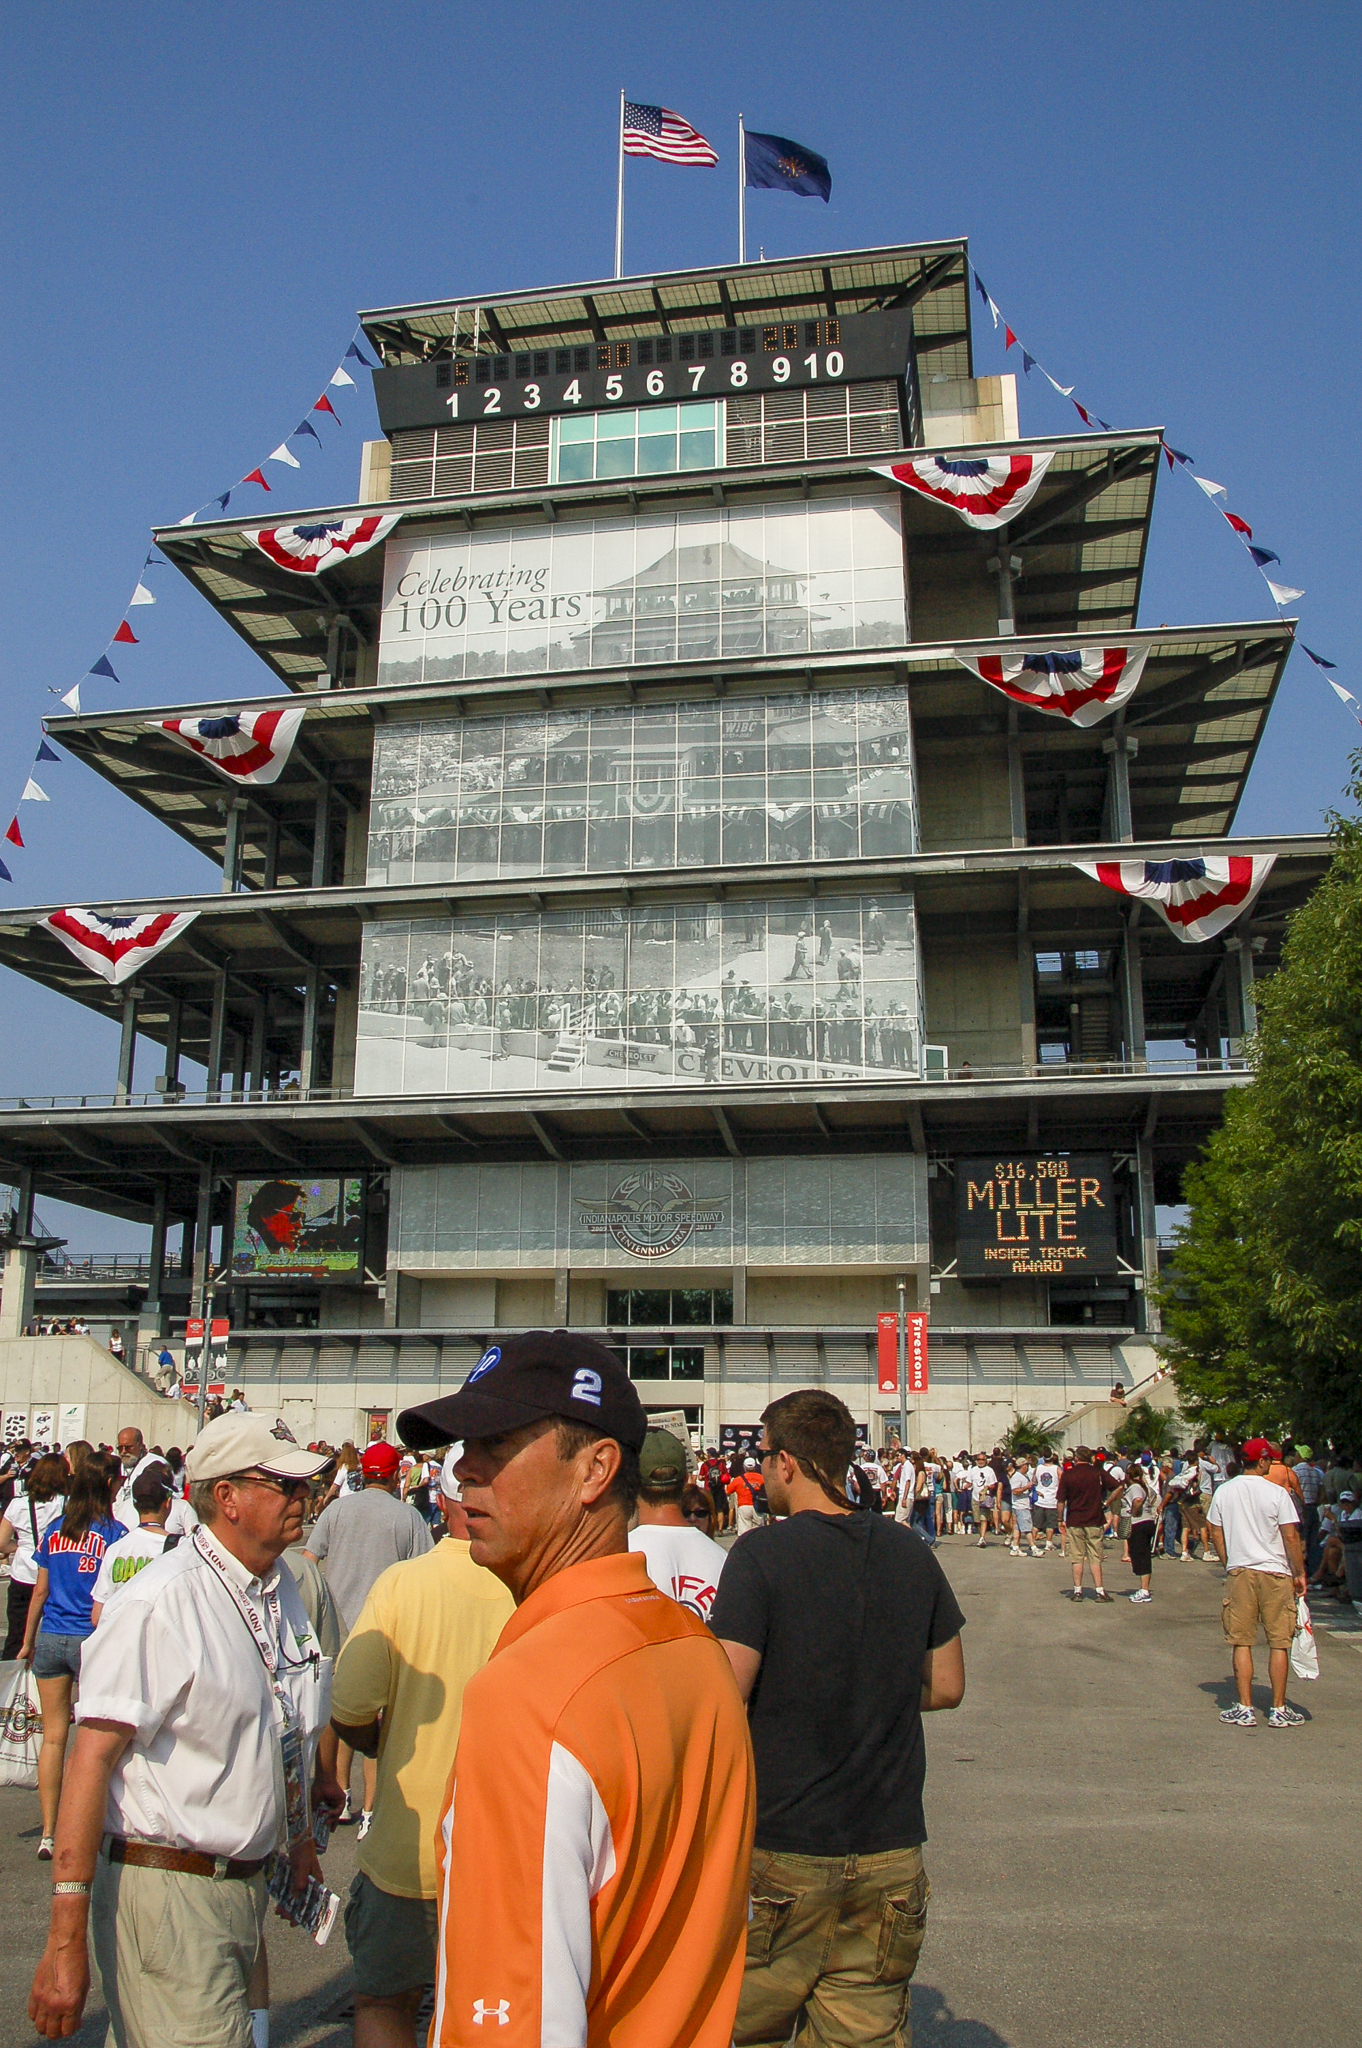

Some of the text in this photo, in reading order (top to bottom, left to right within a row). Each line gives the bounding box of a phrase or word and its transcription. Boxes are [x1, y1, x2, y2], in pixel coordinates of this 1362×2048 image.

[454, 319, 840, 386] 5 30 20 10
[446, 351, 844, 418] 1 2 3 4 5 6 7 8 9 10
[397, 564, 549, 597] Celebrating
[398, 589, 581, 633] 100 Years
[725, 721, 758, 733] WIBC
[608, 1049, 654, 1062] CHEVROLET
[967, 1178, 1106, 1210] MILLER
[583, 1212, 719, 1224] INDIANAPOLIS MOTOR SPEEDWAY
[996, 1209, 1077, 1241] LITE
[616, 1229, 688, 1255] CENTENNIAL ERA
[984, 1246, 1087, 1260] INSIDE TRACK
[1012, 1259, 1064, 1273] AWARD
[911, 1317, 923, 1389] Firestone
[570, 1367, 602, 1406] 2
[78, 1555, 97, 1573] 26
[206, 1549, 227, 1572] INDY
[246, 1606, 263, 1633] INDY
